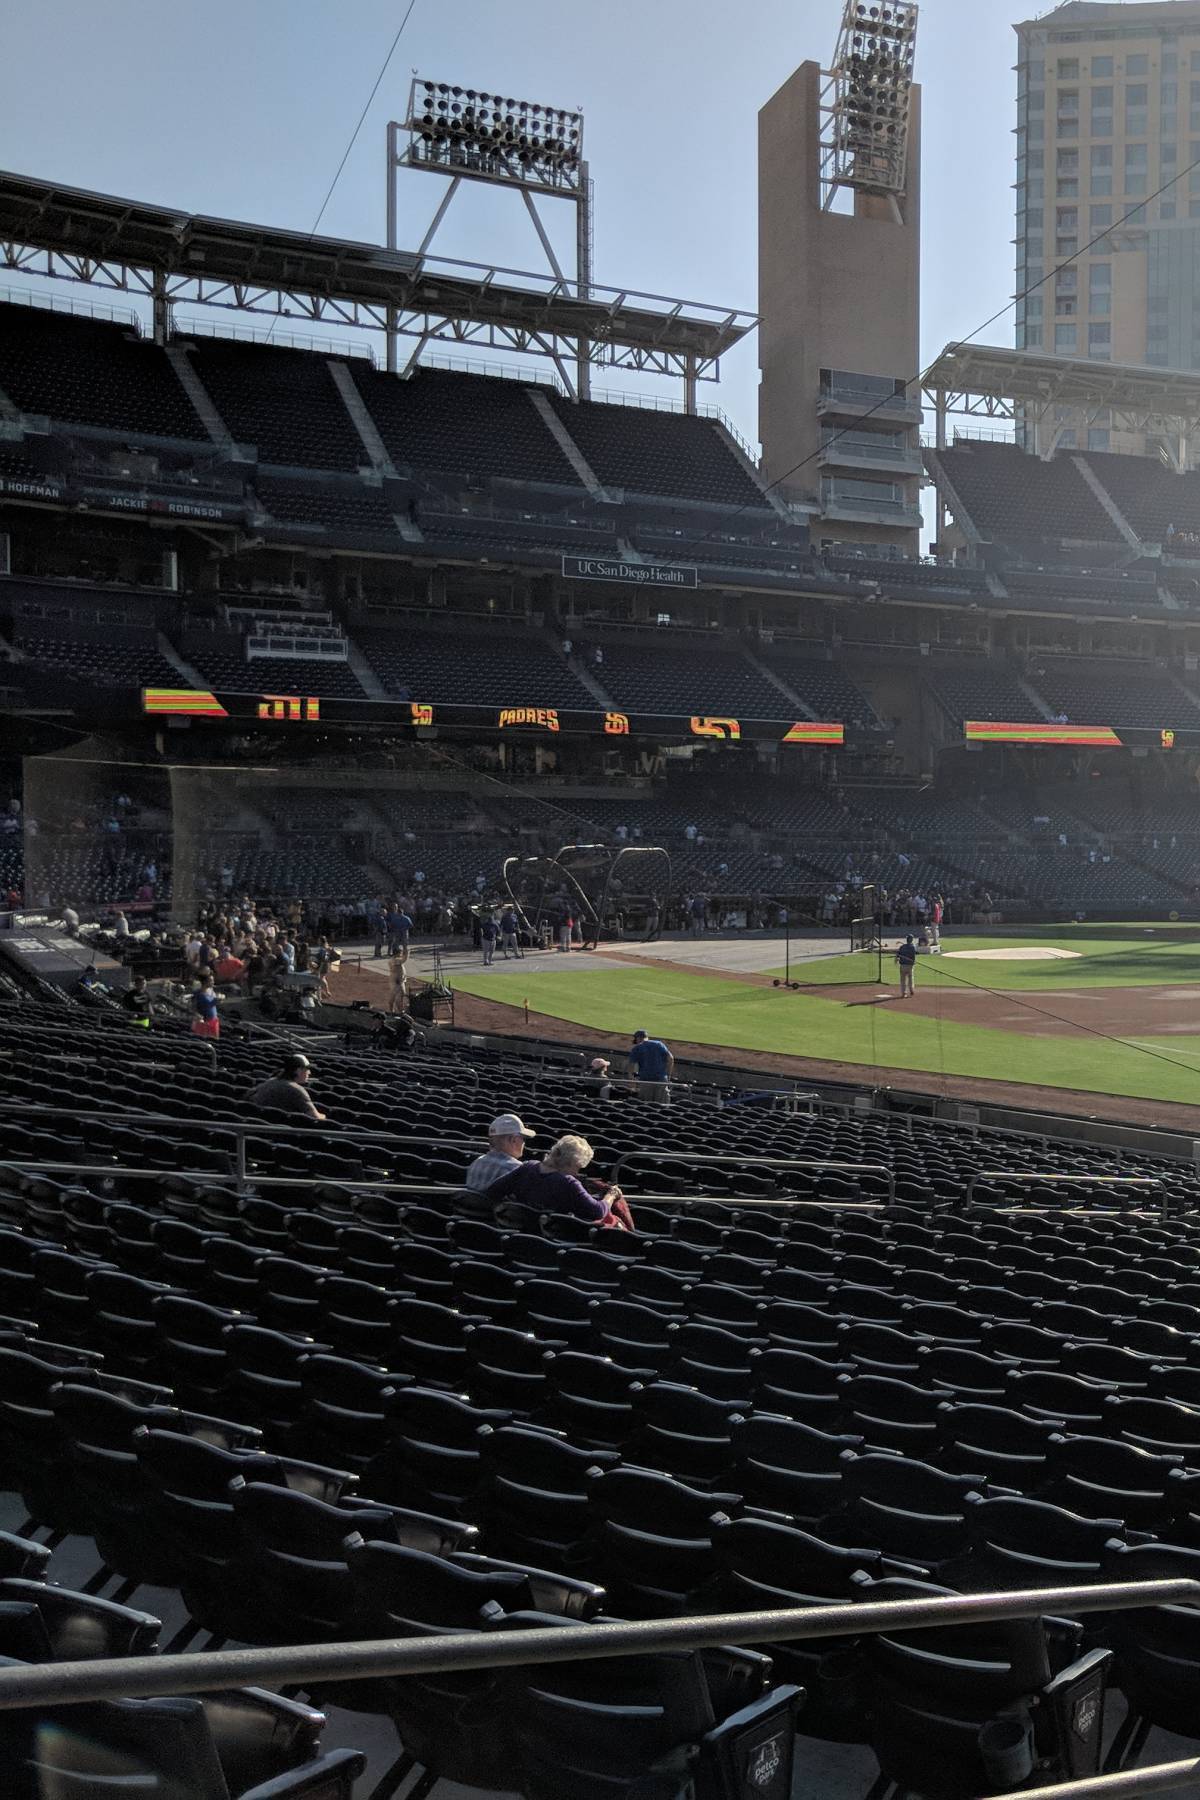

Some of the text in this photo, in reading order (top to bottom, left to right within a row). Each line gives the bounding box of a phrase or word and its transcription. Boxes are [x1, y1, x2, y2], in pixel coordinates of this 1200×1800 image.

[7, 482, 60, 498] HOFFMAN
[109, 497, 148, 509] JACKIE
[168, 503, 223, 518] ROBINSON
[578, 560, 596, 574] UC
[597, 562, 618, 576] San
[620, 564, 649, 580] Diego
[499, 709, 560, 731] PADRES
[755, 1757, 779, 1780] petco
